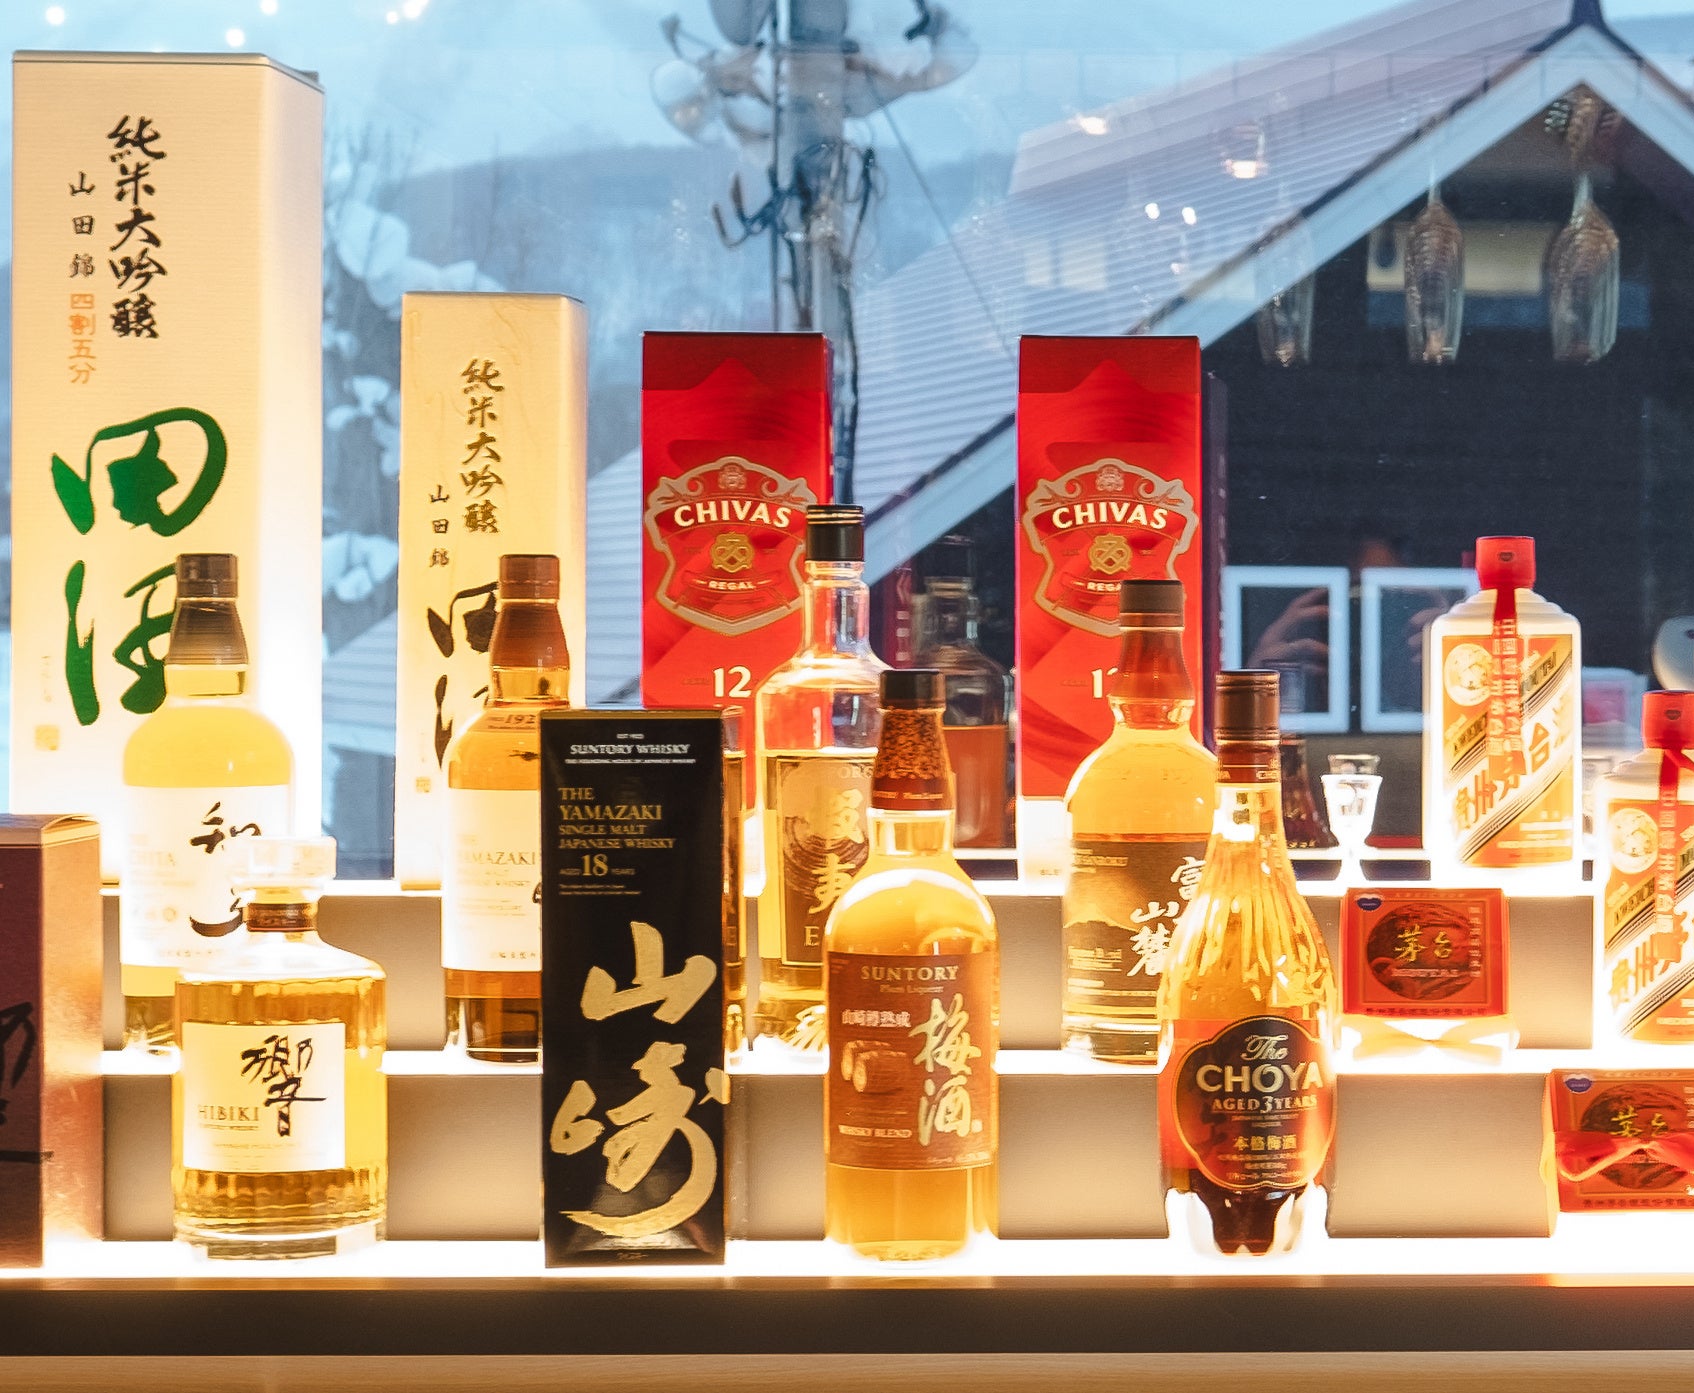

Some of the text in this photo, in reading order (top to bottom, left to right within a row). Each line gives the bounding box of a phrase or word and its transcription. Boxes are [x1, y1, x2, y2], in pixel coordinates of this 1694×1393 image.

[69, 292, 97, 384] 四割五分
[674, 500, 792, 528] CHIVAS
[1052, 501, 1169, 529] CHIVAS
[708, 581, 756, 590] REGAL
[1087, 582, 1122, 592] REGA
[713, 666, 752, 698] 12
[1092, 668, 1119, 698] 1
[570, 744, 690, 755] SUNTORY WHISKY
[559, 787, 594, 801] THE
[559, 804, 663, 821] YAMAZAKI
[610, 824, 648, 835] MALT
[559, 838, 677, 849] JAPANESE WHISKY
[457, 851, 536, 865] MAZAKI
[581, 853, 609, 877] 18
[1394, 924, 1454, 962] 茅台
[861, 966, 959, 981] SUNTORY
[1240, 1034, 1289, 1061] The
[550, 920, 731, 1237] 山崎
[908, 993, 982, 1147] 梅酒
[1196, 1061, 1324, 1094] CHOYA
[199, 1105, 261, 1122] HIBIKI
[1212, 1097, 1260, 1111] AGED
